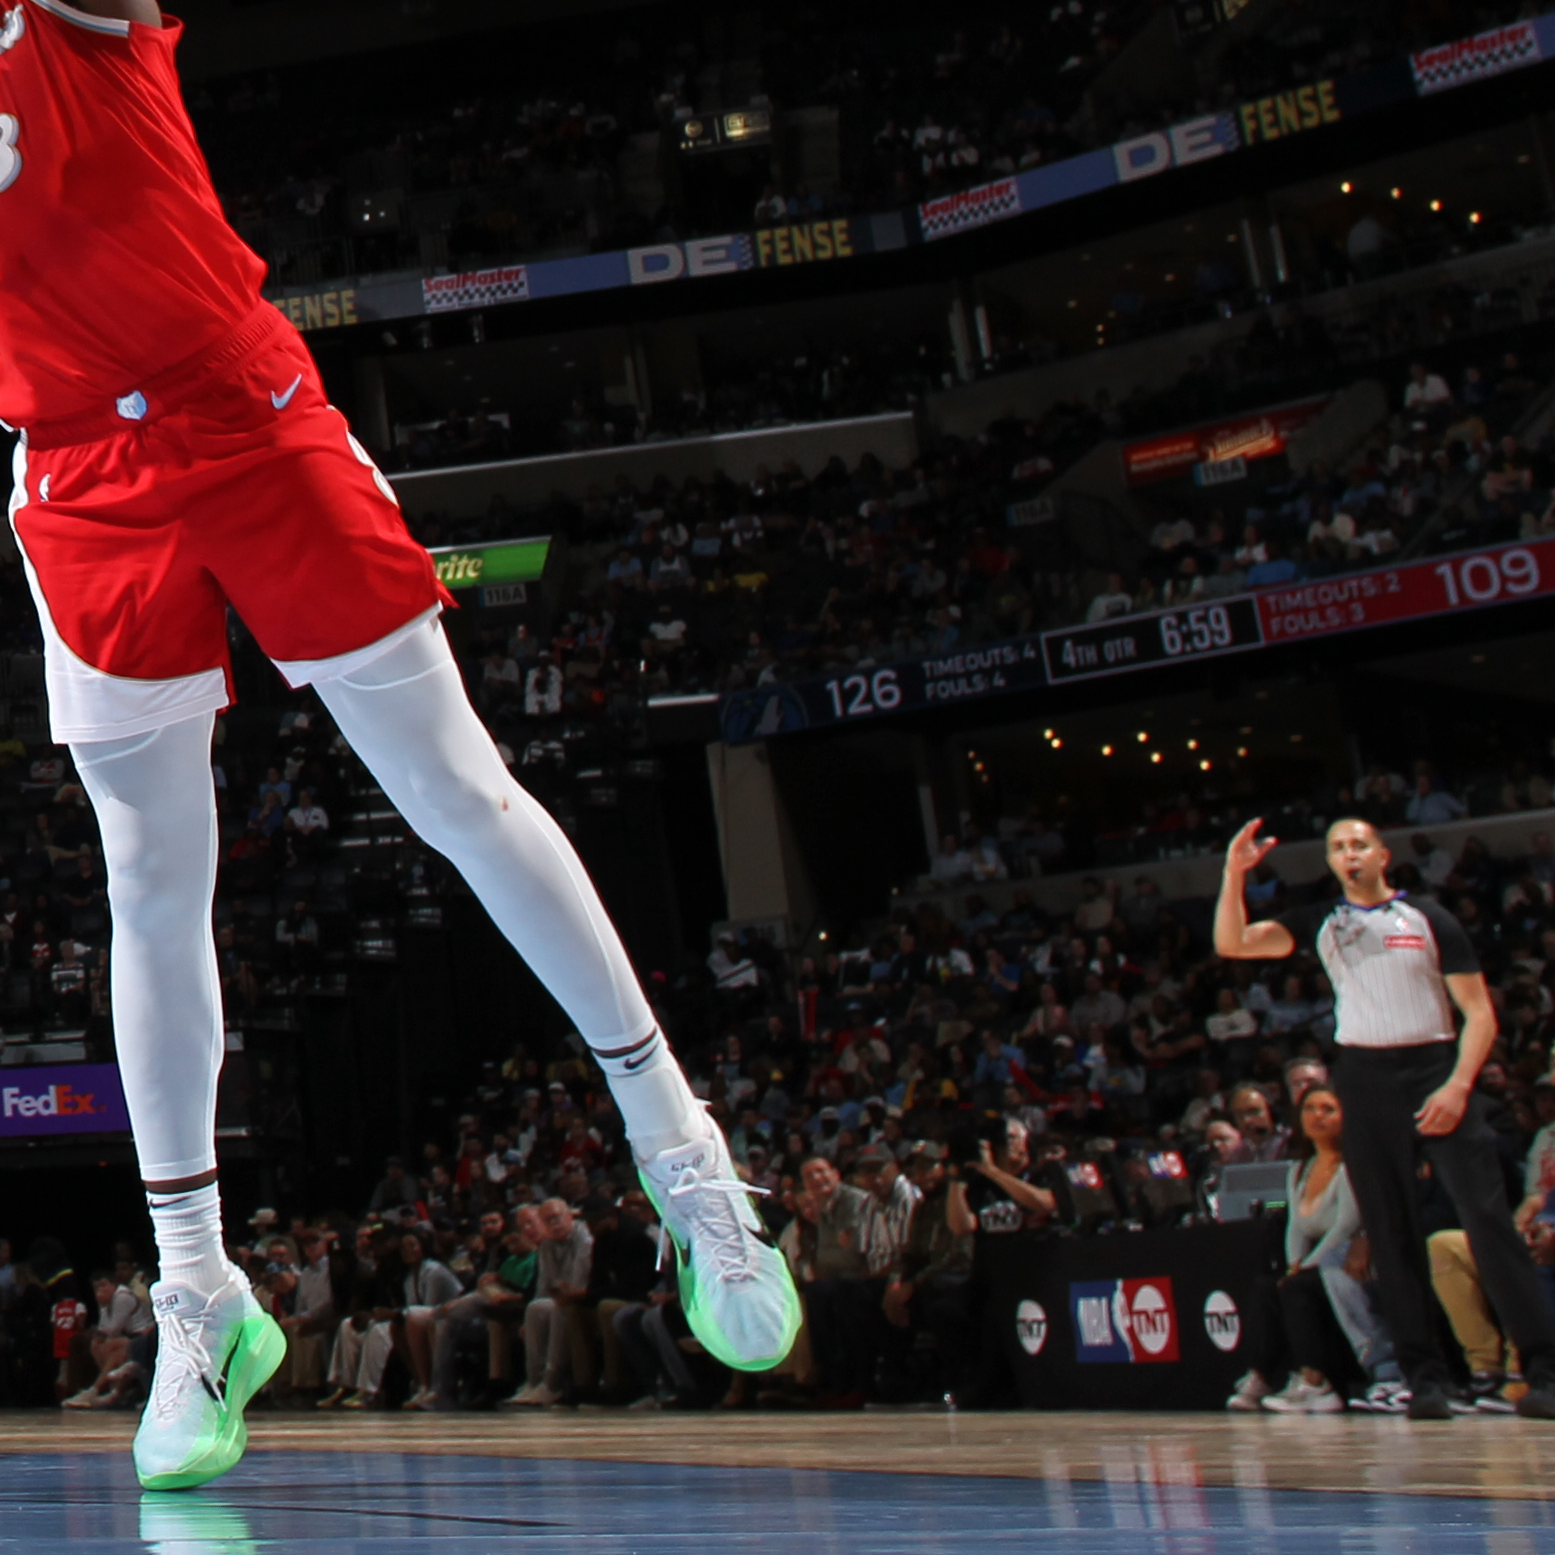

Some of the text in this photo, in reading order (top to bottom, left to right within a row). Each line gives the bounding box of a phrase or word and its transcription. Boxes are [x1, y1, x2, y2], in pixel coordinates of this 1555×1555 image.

[1113, 80, 1341, 182] DE FENSE
[627, 220, 852, 285] DE FENSE
[422, 265, 524, 293] SealMaster
[435, 554, 484, 581] rite
[1435, 548, 1542, 605] 109
[1266, 572, 1402, 614] TIMEOUTS: 2
[1271, 603, 1365, 635] FOULS: 3
[1061, 640, 1097, 670] 4TH
[1160, 606, 1233, 656] 6:59
[922, 642, 1037, 679] TIMEOUTS: 4
[825, 668, 902, 718] 126
[925, 671, 1007, 701] FOULS: 4
[2, 1085, 95, 1118] FedEx
[1077, 1297, 1114, 1346] NBA
[1131, 1310, 1170, 1334] TNT
[1203, 1312, 1240, 1333] TNT
